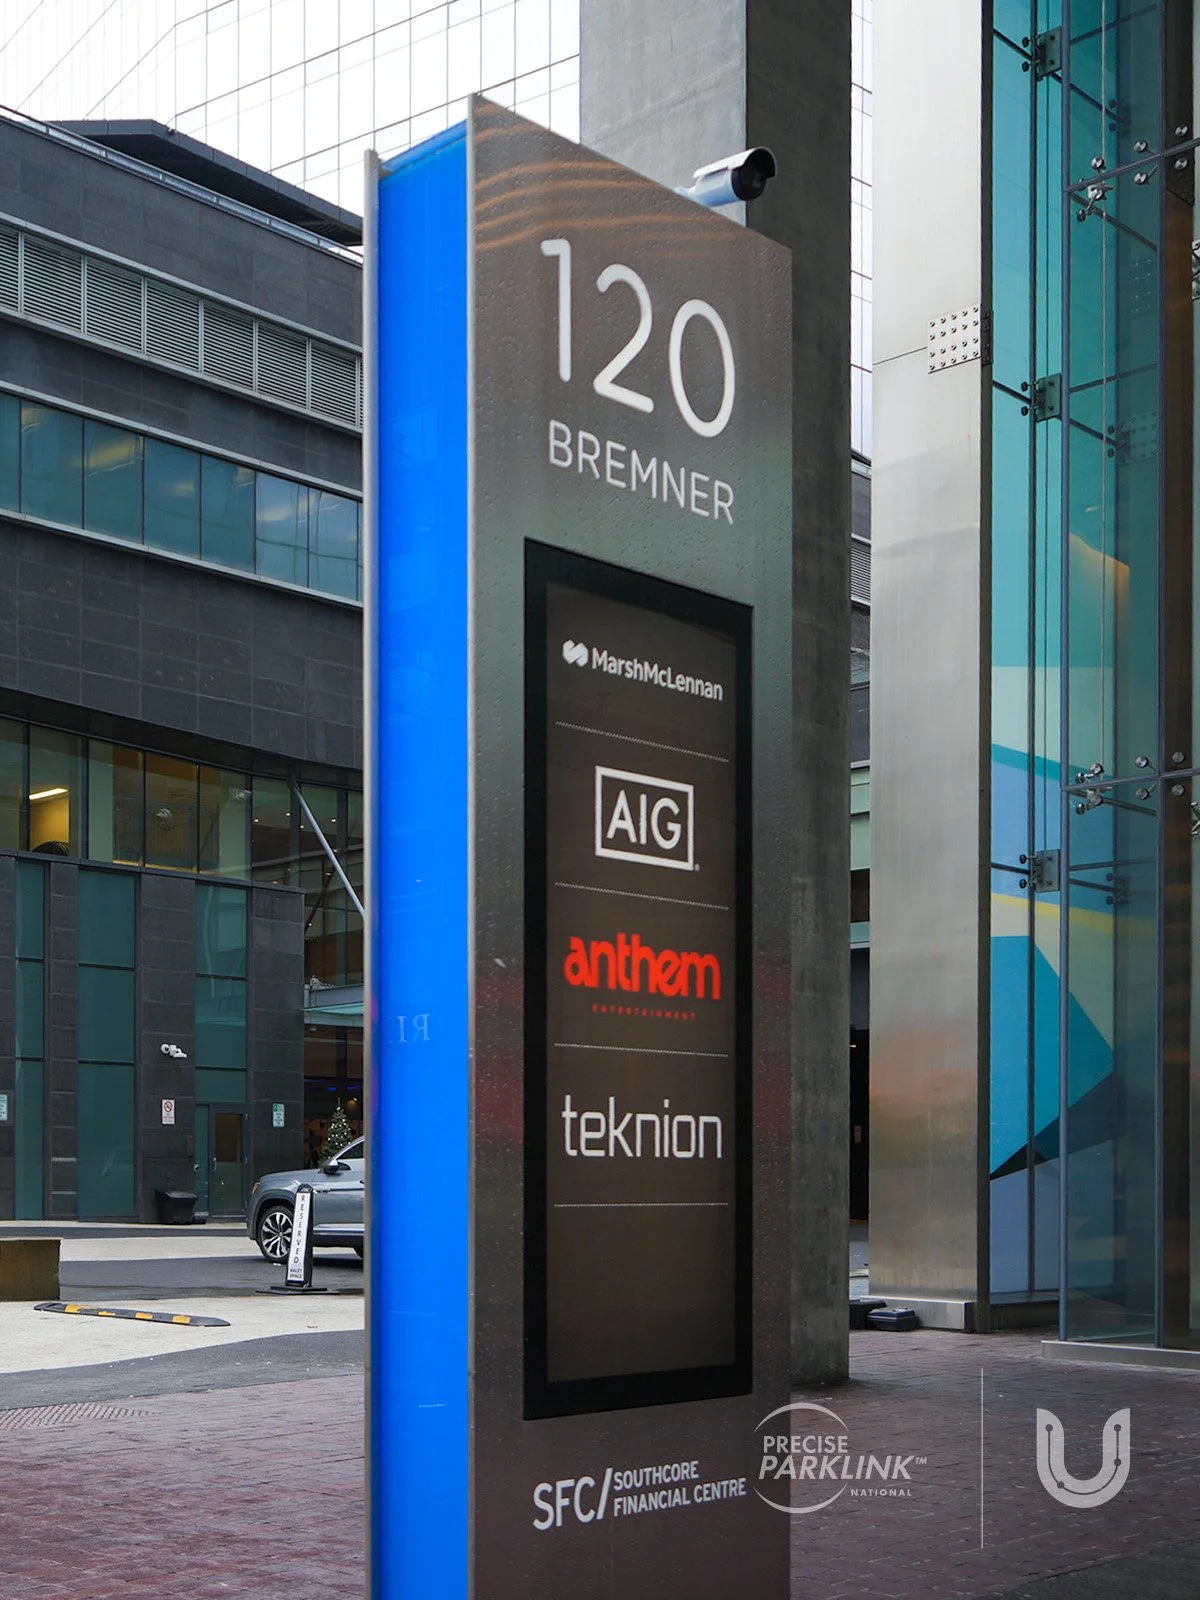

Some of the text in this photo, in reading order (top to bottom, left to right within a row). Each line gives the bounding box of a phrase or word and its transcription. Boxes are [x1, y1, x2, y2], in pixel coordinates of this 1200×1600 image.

[540, 238, 735, 438] 120
[549, 419, 734, 525] BREMNER
[592, 647, 723, 701] MarshMcLennan
[606, 789, 682, 850] AIG
[564, 932, 721, 1000] anthem
[561, 1094, 722, 1158] teknion
[293, 1195, 306, 1264] RESERVED
[613, 1460, 699, 1491] SOUTHCORE
[613, 1478, 747, 1517] FINANCIAL CENTRE
